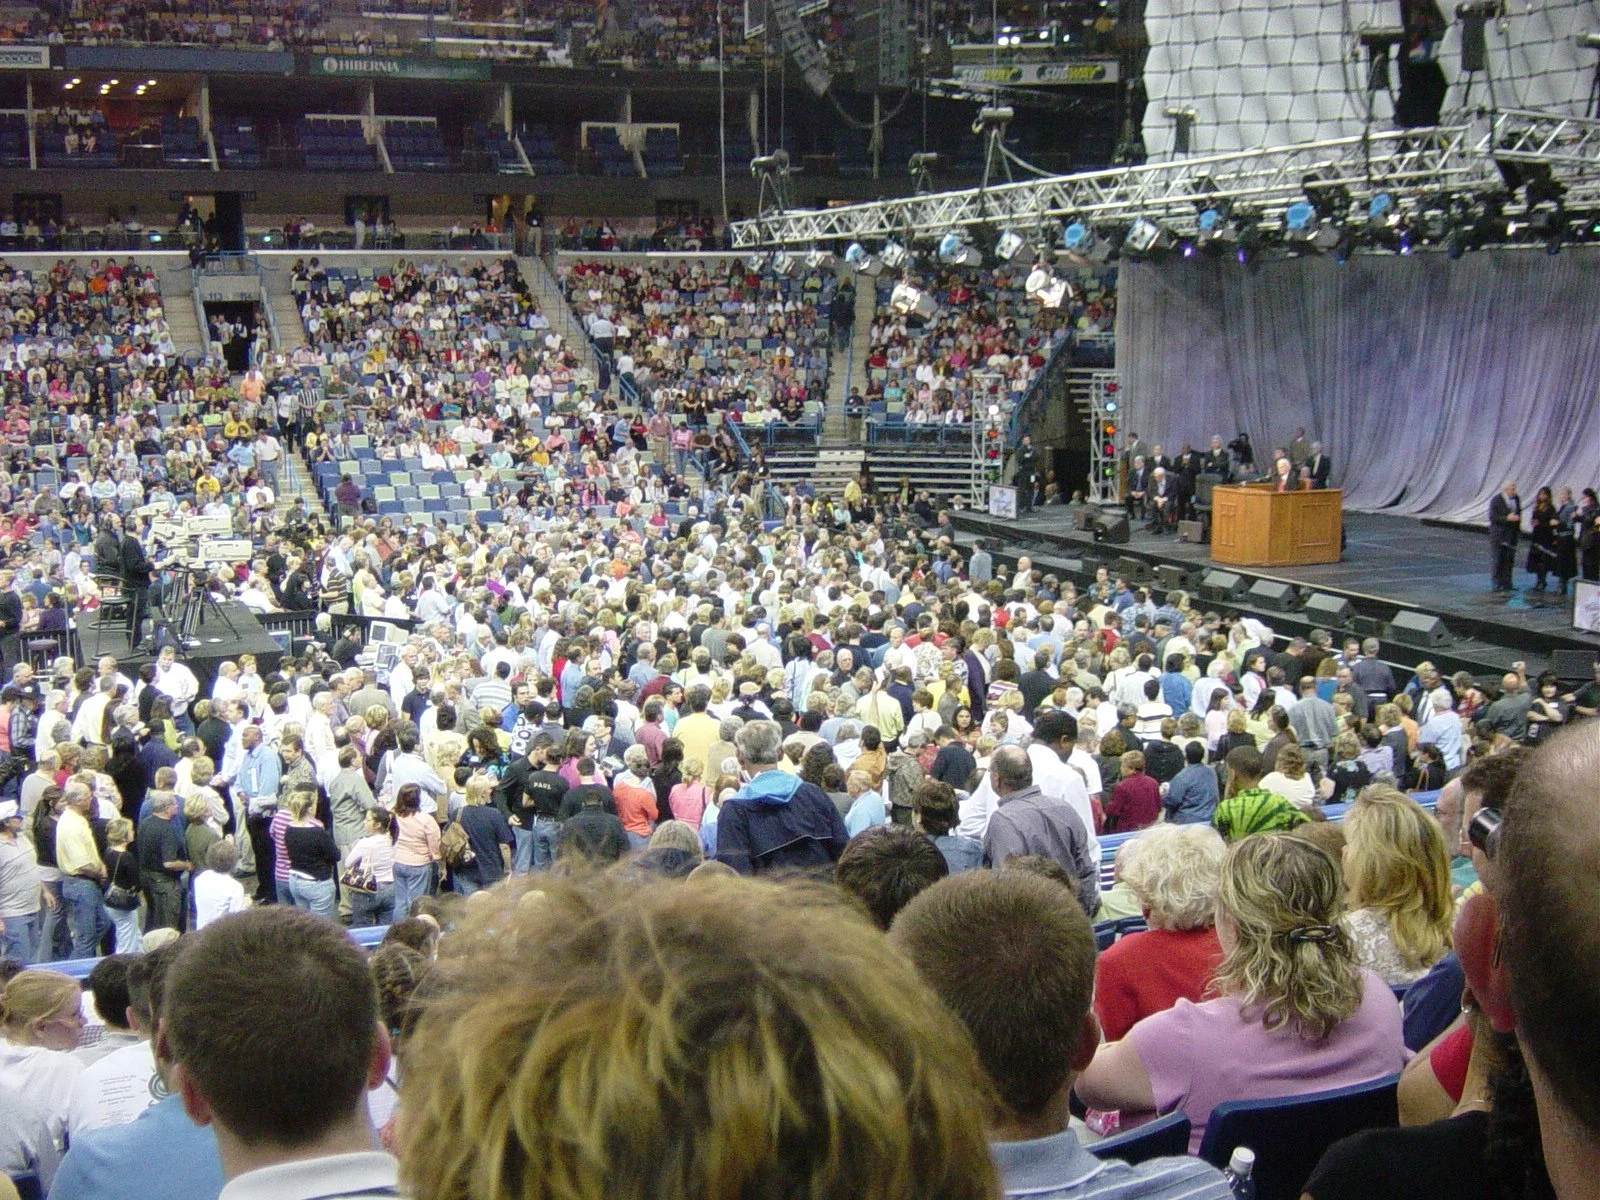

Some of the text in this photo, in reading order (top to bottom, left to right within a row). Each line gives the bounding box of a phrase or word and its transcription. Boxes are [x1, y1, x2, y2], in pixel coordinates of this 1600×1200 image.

[338, 59, 400, 73] HIBERNIA
[957, 66, 1022, 82] SUBWAY
[1037, 64, 1105, 81] SUBWAY
